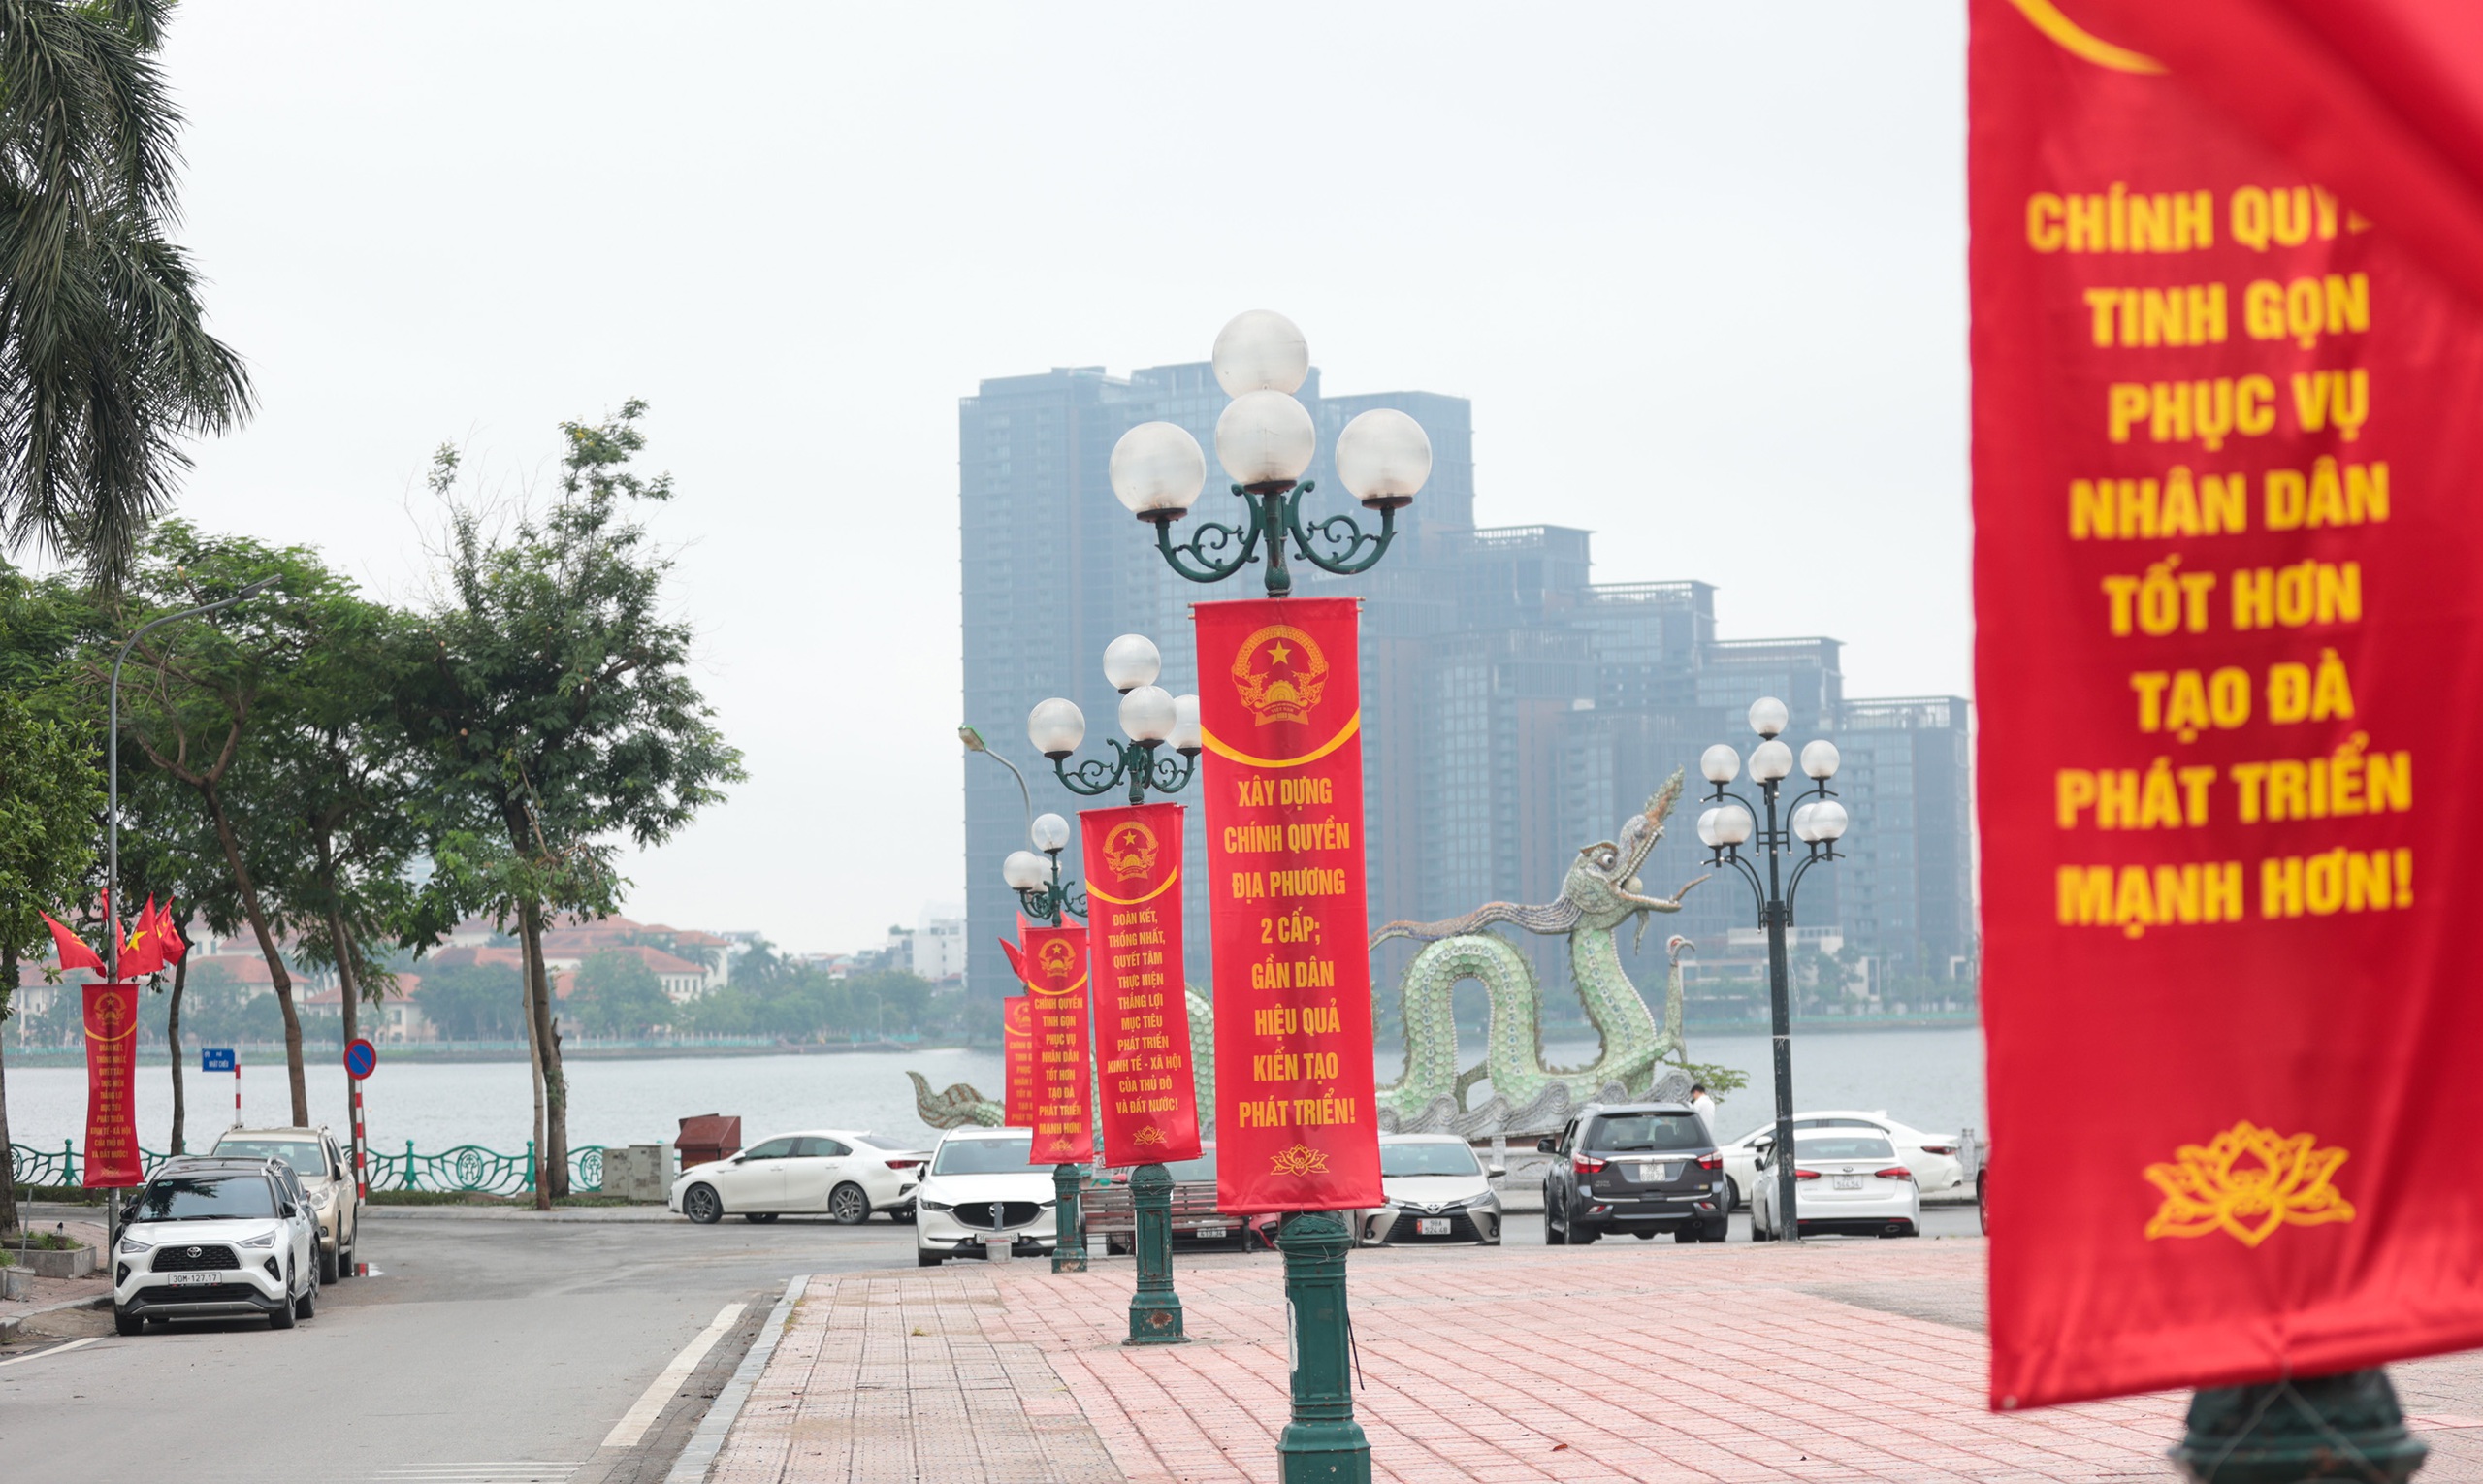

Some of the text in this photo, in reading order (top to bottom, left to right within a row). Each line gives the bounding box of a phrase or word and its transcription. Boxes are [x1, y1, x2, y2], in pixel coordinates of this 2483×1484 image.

[2028, 182, 2213, 252] CHÍNH
[2084, 274, 2370, 350] TINH GỌN
[2110, 369, 2369, 451] PHỤC VỤ
[2070, 457, 2389, 538] NHÂN DÂN
[2103, 555, 2361, 635] TỐT HƠN
[2131, 649, 2354, 742] TẠO ĐÀ
[1238, 775, 1332, 810] XÂY DỰNG
[2057, 732, 2411, 829] PHÁT TRIỂN
[1224, 815, 1349, 854] CHÍNH QUYỀN
[1232, 867, 1345, 904] ĐỊA PHƯƠNG
[2057, 848, 2412, 938] MẠNH HƠN!
[1113, 907, 1157, 926] ĐOÀN KẾT,
[1261, 906, 1320, 945] 2 CẤP;
[1108, 927, 1165, 948] THỐNG NHẤT,
[1113, 950, 1162, 969] QUYẾT TÂM
[1252, 955, 1334, 989] GẦN DÂN
[1117, 971, 1164, 990] THỰC HIỆN
[1117, 992, 1163, 1010] THẮNG LỢI
[1255, 998, 1340, 1041] HIỆU QUẢ
[1117, 1031, 1169, 1051] PHÁT TRIỂN
[1121, 1013, 1162, 1032] MỤC TIÊU
[1108, 1059, 1128, 1073] KINH
[1131, 1054, 1142, 1071] TẾ
[1150, 1055, 1163, 1070] XÃ
[1166, 1053, 1181, 1071] HỘI
[1254, 1046, 1338, 1084] KIẾN TẠO
[1119, 1075, 1172, 1093] CỦA THỦ ĐÔ
[1116, 1096, 1178, 1113] VÀ ĐẤT NƯỚC!
[1240, 1087, 1355, 1127] PHÁT TRIỂN!
[173, 1274, 217, 1283] 30M-127.17
